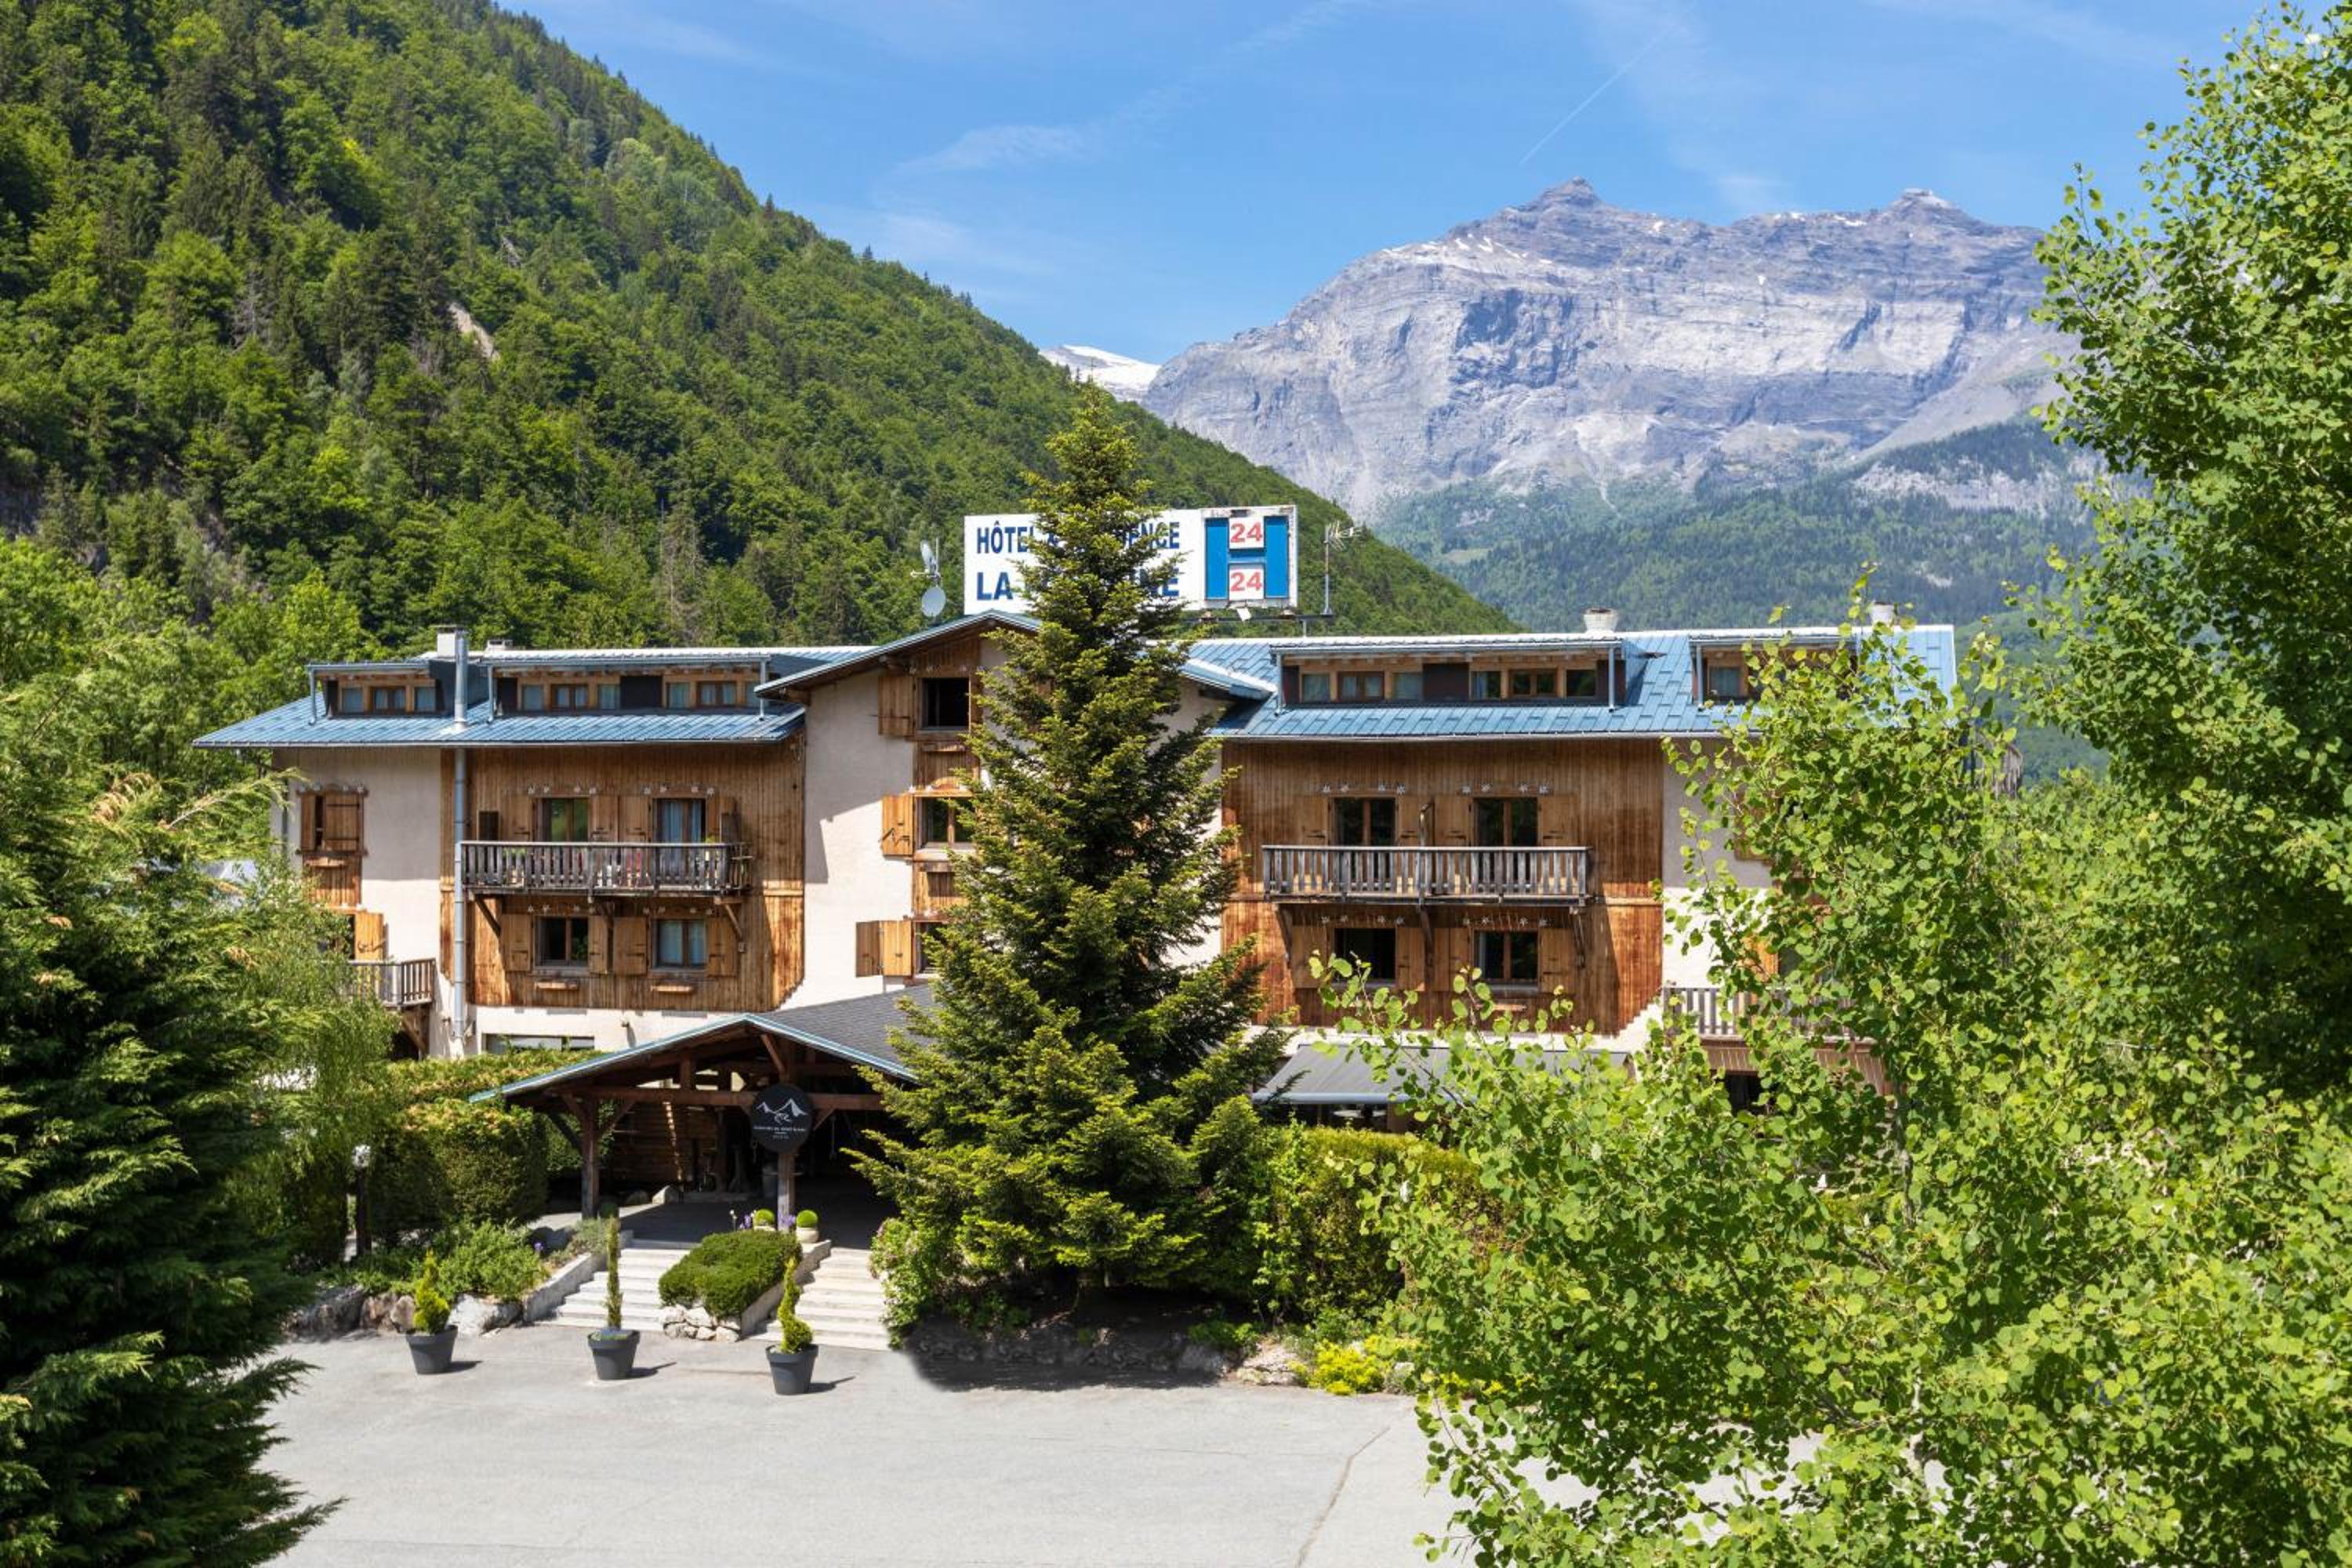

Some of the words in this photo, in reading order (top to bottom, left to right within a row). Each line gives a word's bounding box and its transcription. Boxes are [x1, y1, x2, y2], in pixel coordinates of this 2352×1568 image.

[1230, 521, 1262, 543] 24
[977, 572, 1014, 601] LA
[1230, 572, 1262, 592] 24
